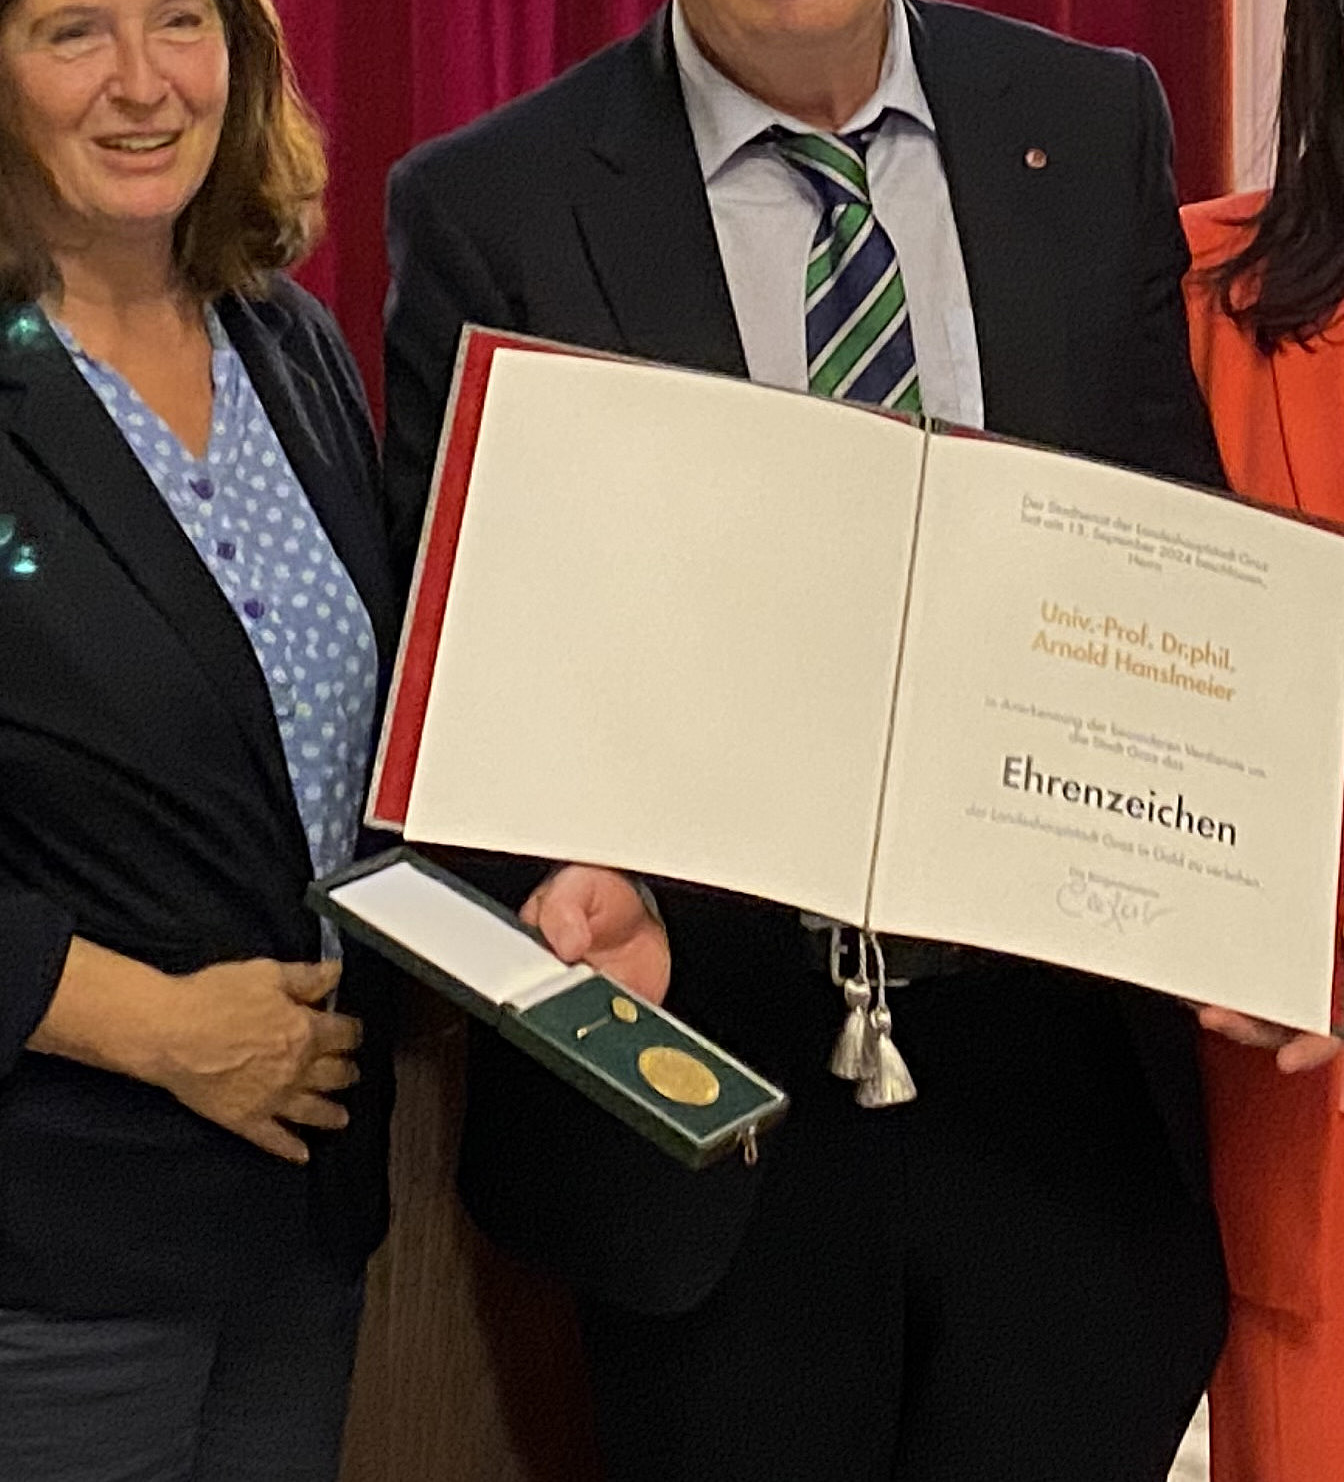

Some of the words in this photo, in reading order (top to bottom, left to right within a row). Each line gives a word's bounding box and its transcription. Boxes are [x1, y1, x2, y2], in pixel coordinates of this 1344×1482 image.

[1031, 628, 1108, 669] Arnold
[1115, 646, 1236, 702] Hanslmeier
[1002, 753, 1236, 847] Ehrenzeichen
